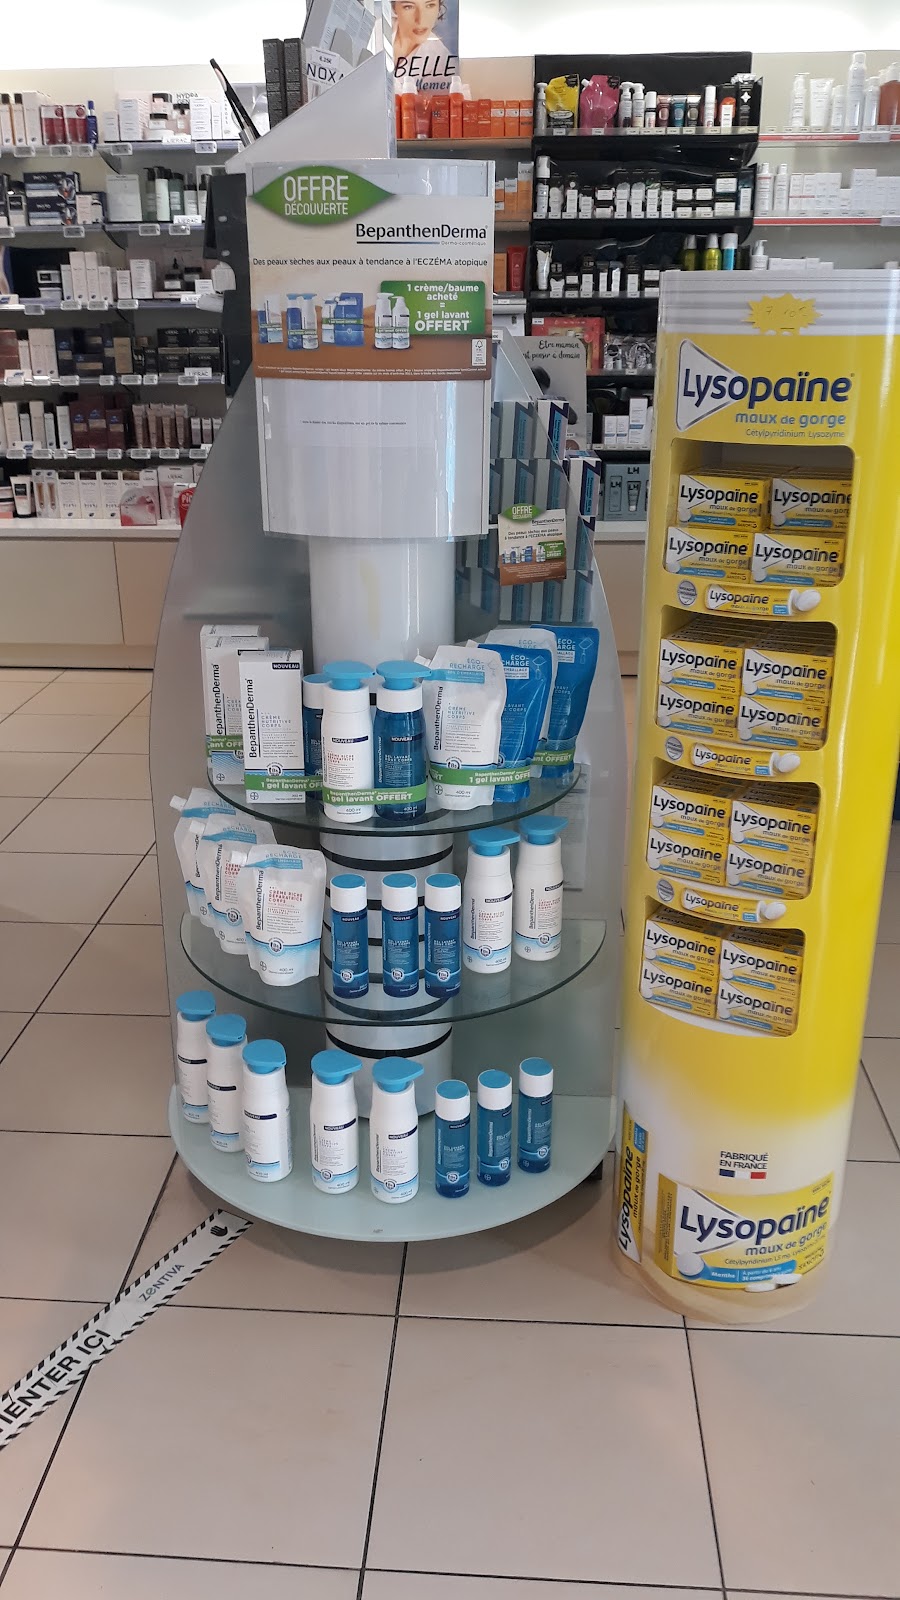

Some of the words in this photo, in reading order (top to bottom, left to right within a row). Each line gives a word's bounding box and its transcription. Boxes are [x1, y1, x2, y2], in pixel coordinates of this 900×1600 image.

[394, 55, 459, 78] BELLE
[283, 175, 349, 202] OFFRE
[284, 201, 349, 216] DÉCOUVERTE
[267, 259, 288, 267] peaux
[290, 257, 314, 265] sèches
[332, 259, 357, 267] peaux
[366, 257, 404, 266] tendance
[413, 256, 452, 266] l'ECZÉMA
[454, 258, 487, 266] atopique
[407, 283, 411, 291] 1
[414, 283, 479, 292] crème/baume
[426, 292, 458, 301] acheté
[424, 310, 439, 320] gel
[441, 310, 469, 319] lavant
[683, 368, 852, 409] Lysopaïne
[735, 413, 777, 423] maux
[781, 415, 795, 424] de
[799, 414, 846, 427] gorge
[808, 430, 845, 439] Lysozyme
[680, 485, 759, 504] Lysopaïne
[512, 505, 532, 515] OFFRE
[669, 537, 748, 556] Lysopaïne
[755, 544, 839, 563] Lysopaïne
[710, 590, 769, 604] Lysopaïne
[449, 663, 485, 671] RECHARGE
[510, 654, 530, 662] ÉCO-
[661, 649, 737, 670] Lysopaïne
[717, 671, 737, 679] gorge
[745, 659, 827, 680] Lysopaïne
[804, 681, 826, 690] gorge
[212, 664, 224, 735] epanthenDerma
[660, 694, 735, 715] Lysopaïne
[245, 678, 255, 759] BepanthenDerma
[741, 705, 821, 728] Lysopaïne
[545, 754, 572, 762] OFFERT
[695, 749, 751, 764] Lysopaïne
[267, 781, 280, 789] gel
[281, 781, 307, 789] lavant
[475, 776, 488, 785] gel
[489, 774, 513, 783] lavant
[346, 795, 374, 803] lavant
[376, 793, 413, 802] OFFERT
[653, 795, 726, 819] Lysopaïne
[680, 814, 697, 822] maux
[705, 818, 725, 827] gorge
[733, 810, 811, 834] Lysopaïne
[650, 838, 722, 862] Lysopaïne
[729, 853, 805, 878] Lysopaïne
[685, 893, 739, 912] Lysopaïne
[646, 929, 716, 956] Lysopaïne
[723, 949, 798, 975] Lysopaïne
[643, 968, 712, 996] Lysopaïne
[720, 989, 793, 1016] Lysopaïne
[719, 1159, 732, 1167] EN
[733, 1160, 768, 1170] FRANCE
[720, 1150, 769, 1162] FABRIQUÉ
[680, 1196, 830, 1246] Lysopaïne
[745, 1243, 783, 1256] maux
[785, 1241, 797, 1250] de
[799, 1222, 828, 1247] gorge
[711, 1270, 736, 1279] Menthe
[0, 1355, 82, 1433] IENTER
[76, 1329, 111, 1356] ICI
